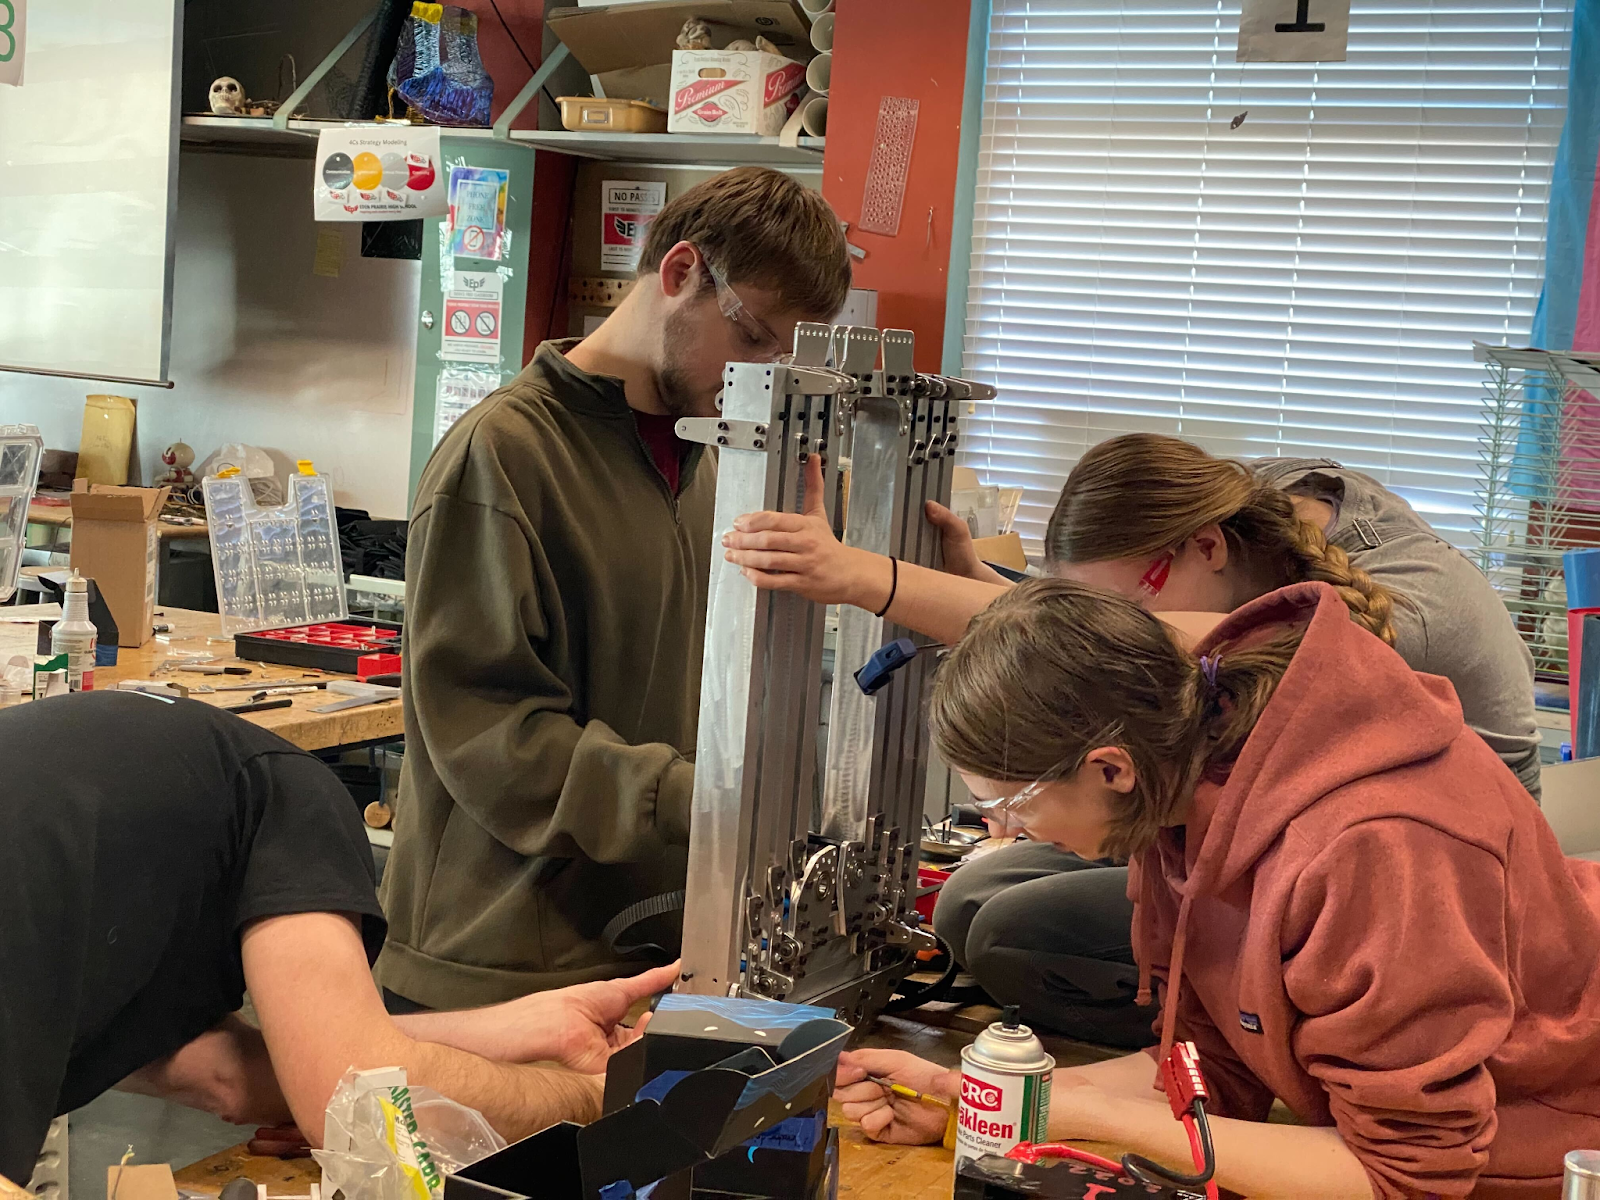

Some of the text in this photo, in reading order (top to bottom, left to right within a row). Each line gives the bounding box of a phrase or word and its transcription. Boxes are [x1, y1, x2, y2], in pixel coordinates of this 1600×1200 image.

[675, 80, 725, 111] Premium
[466, 191, 489, 199] PHONE
[614, 192, 627, 201] NO
[960, 1078, 998, 1107] CRC
[976, 1136, 1002, 1149] Cleaner
